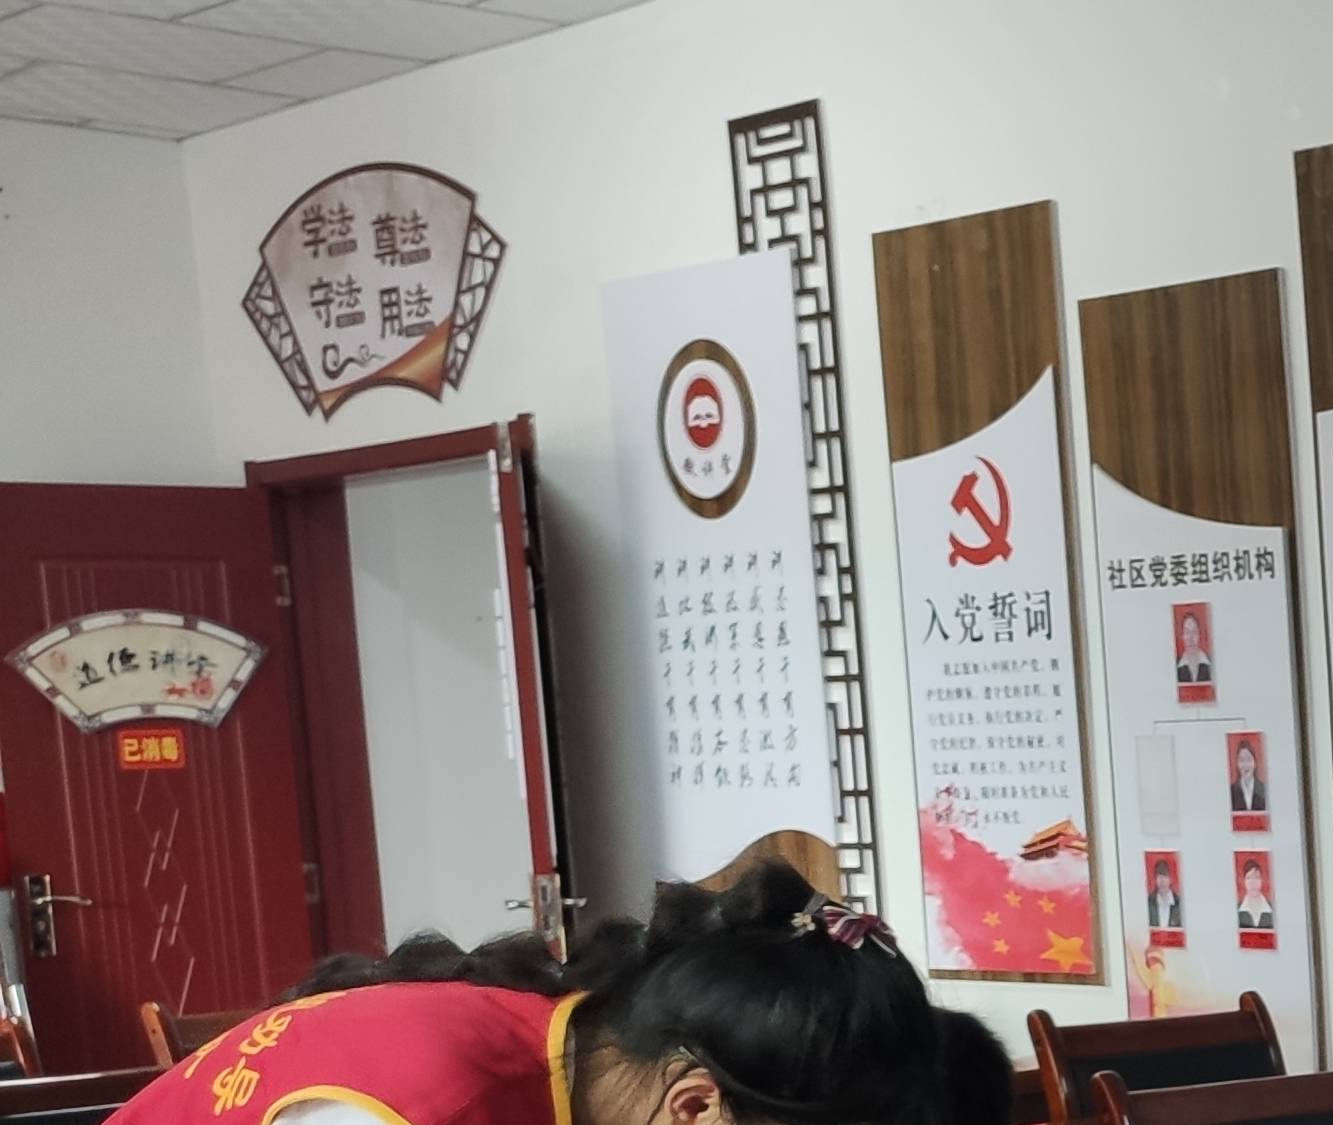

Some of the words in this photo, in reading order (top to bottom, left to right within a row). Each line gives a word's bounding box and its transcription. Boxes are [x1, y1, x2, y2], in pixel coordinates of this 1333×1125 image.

[302, 201, 355, 258] 学法
[372, 208, 428, 267] 尊法
[309, 274, 362, 328] 守法
[379, 282, 433, 339] 用法
[1107, 546, 1276, 591] 社区党委组织机构
[922, 588, 1053, 645] 入党誓词
[123, 736, 179, 762] 已消毒
